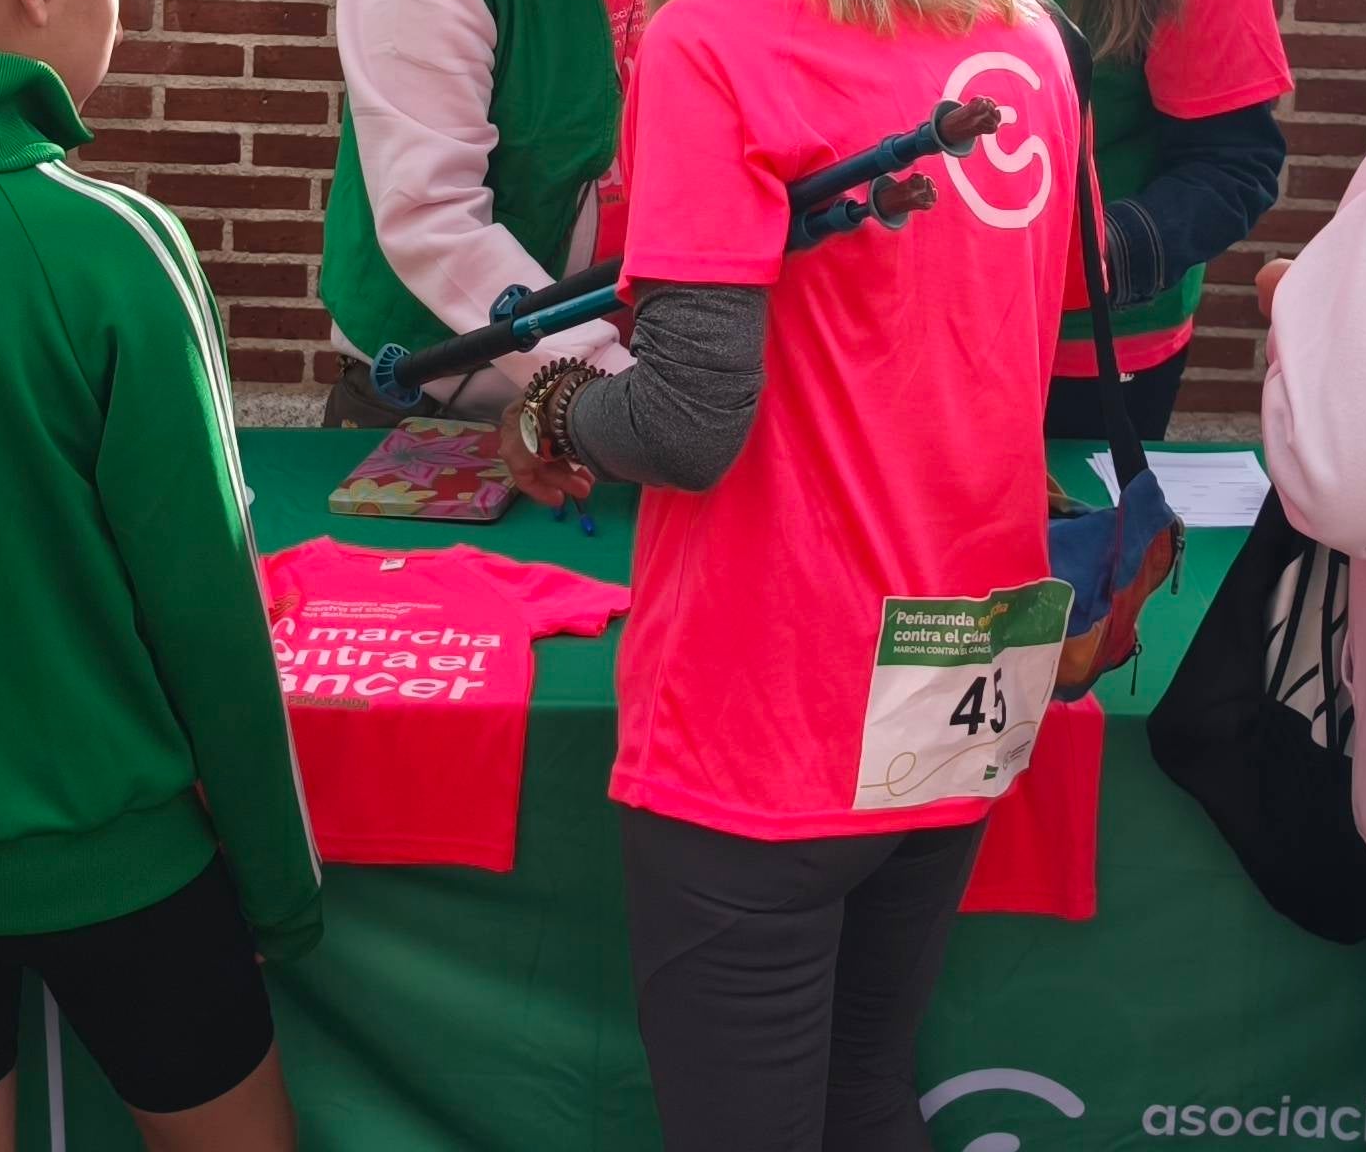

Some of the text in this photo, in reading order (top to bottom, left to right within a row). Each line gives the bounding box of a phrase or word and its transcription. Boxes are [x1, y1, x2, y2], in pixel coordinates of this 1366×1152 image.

[896, 611, 975, 628] Peñaranda
[308, 627, 501, 649] marcha
[893, 628, 992, 645] contra el cán
[272, 638, 487, 673] ontra el
[279, 666, 485, 701] áncer
[949, 667, 1007, 736] 45
